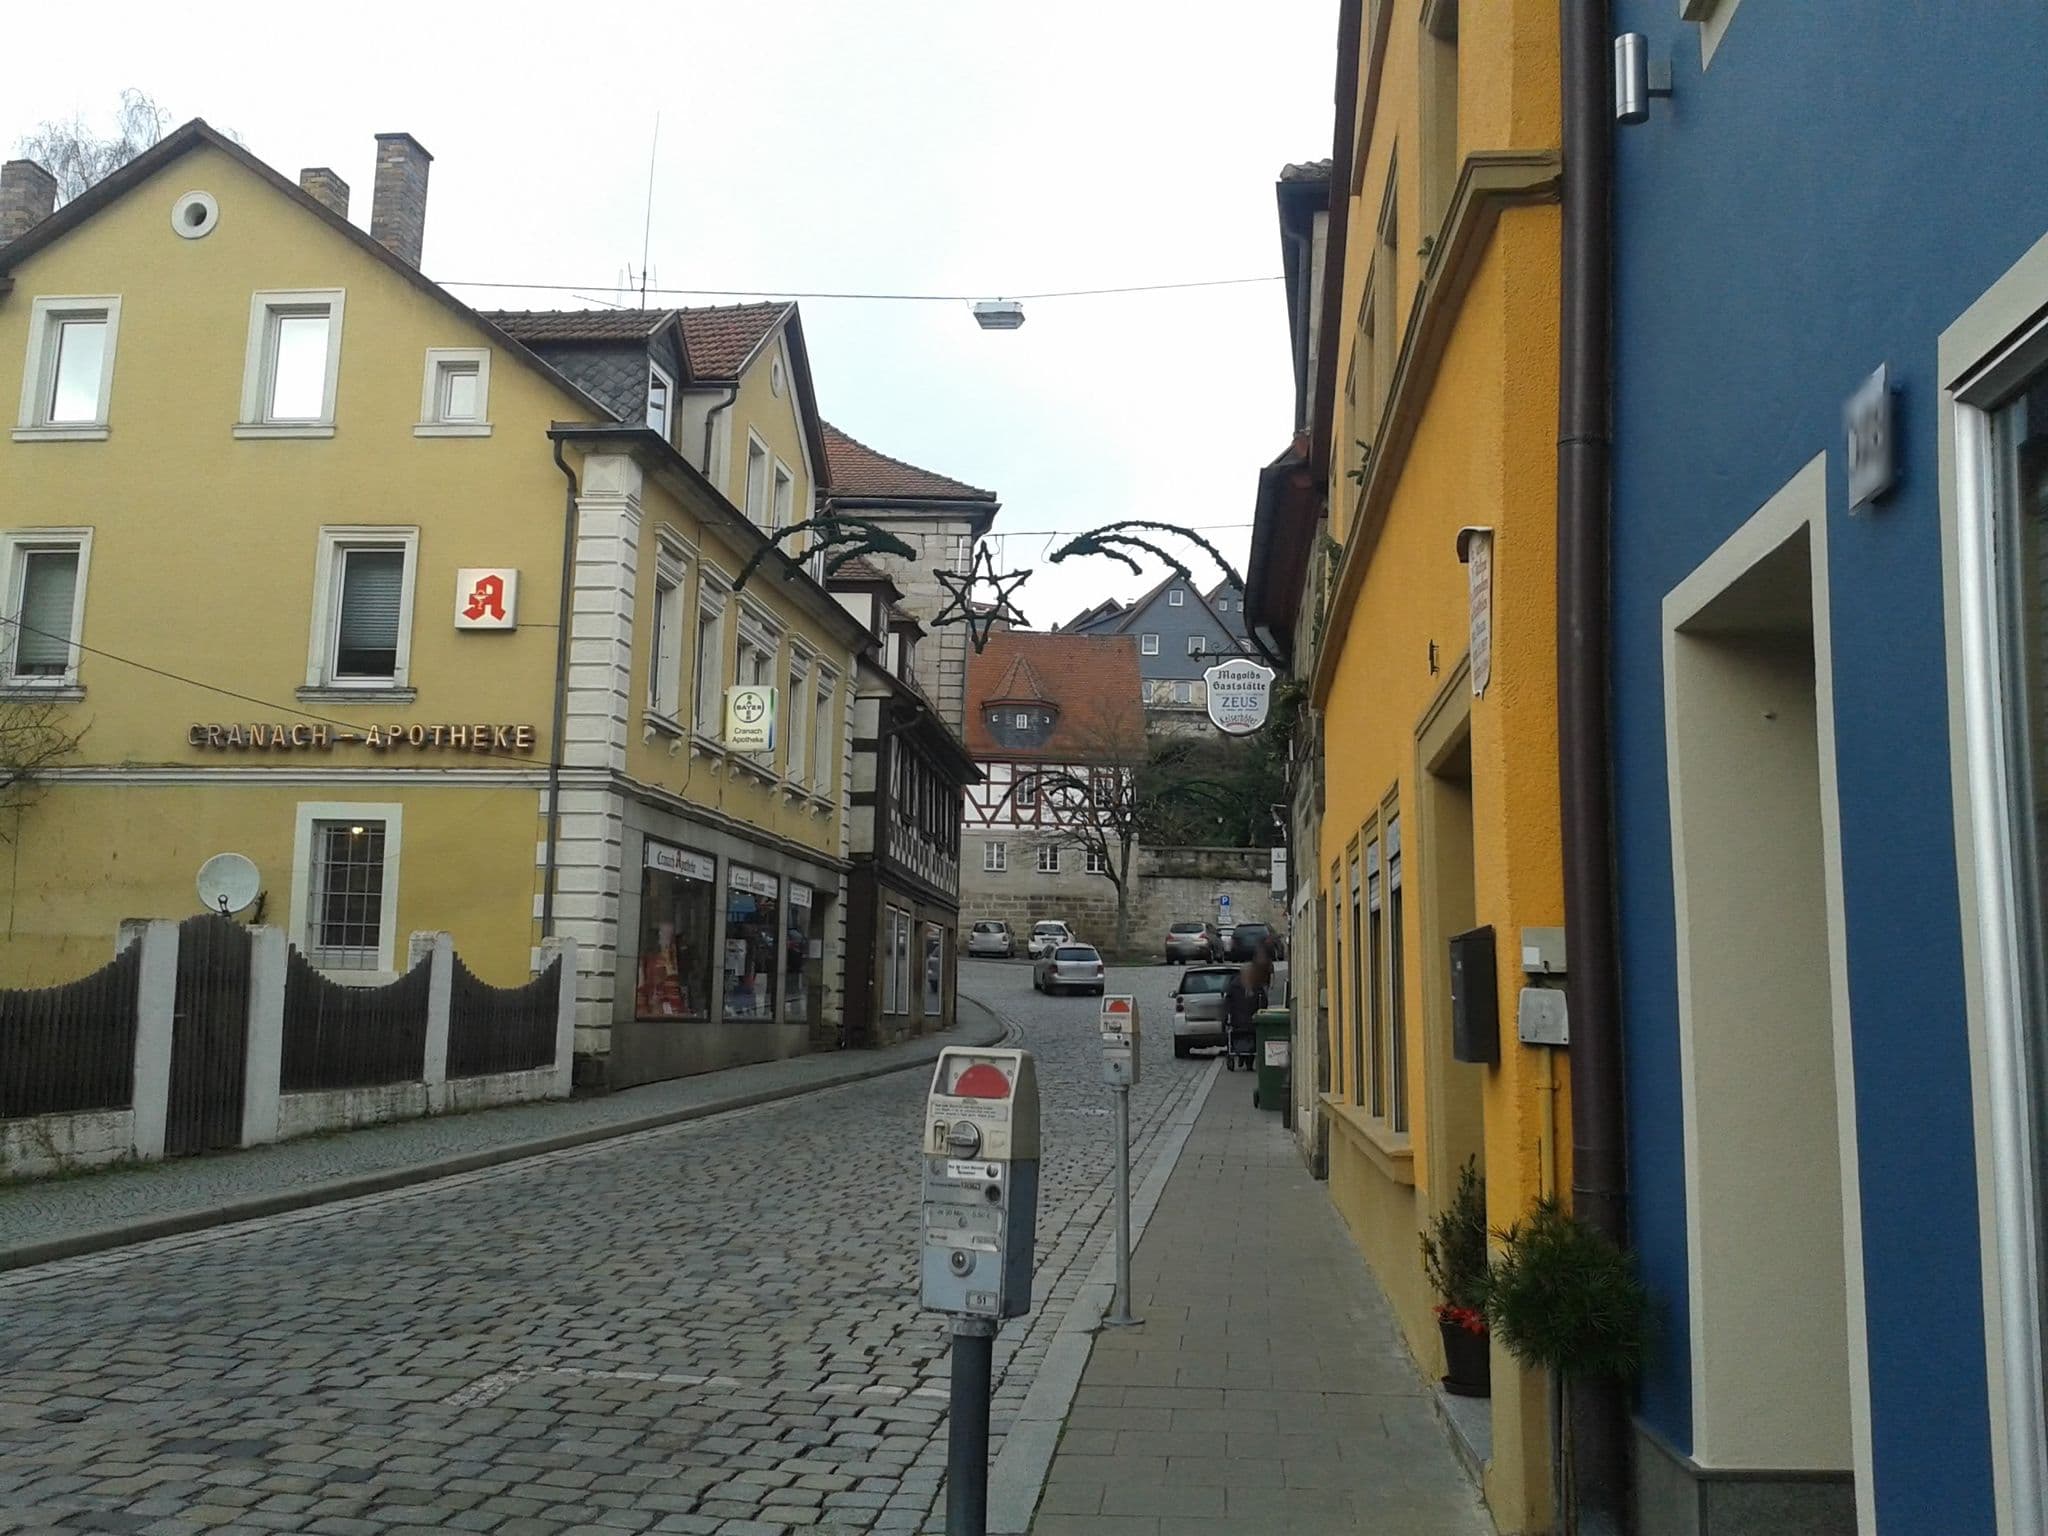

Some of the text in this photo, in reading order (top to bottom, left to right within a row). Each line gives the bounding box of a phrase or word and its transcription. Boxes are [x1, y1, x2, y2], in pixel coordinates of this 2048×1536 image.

[1217, 670, 1261, 681] Magolds
[1212, 680, 1266, 691] Gaststätte
[1221, 696, 1258, 708] ZEUS
[734, 727, 763, 735] Cranach
[731, 736, 764, 744] Apotheke
